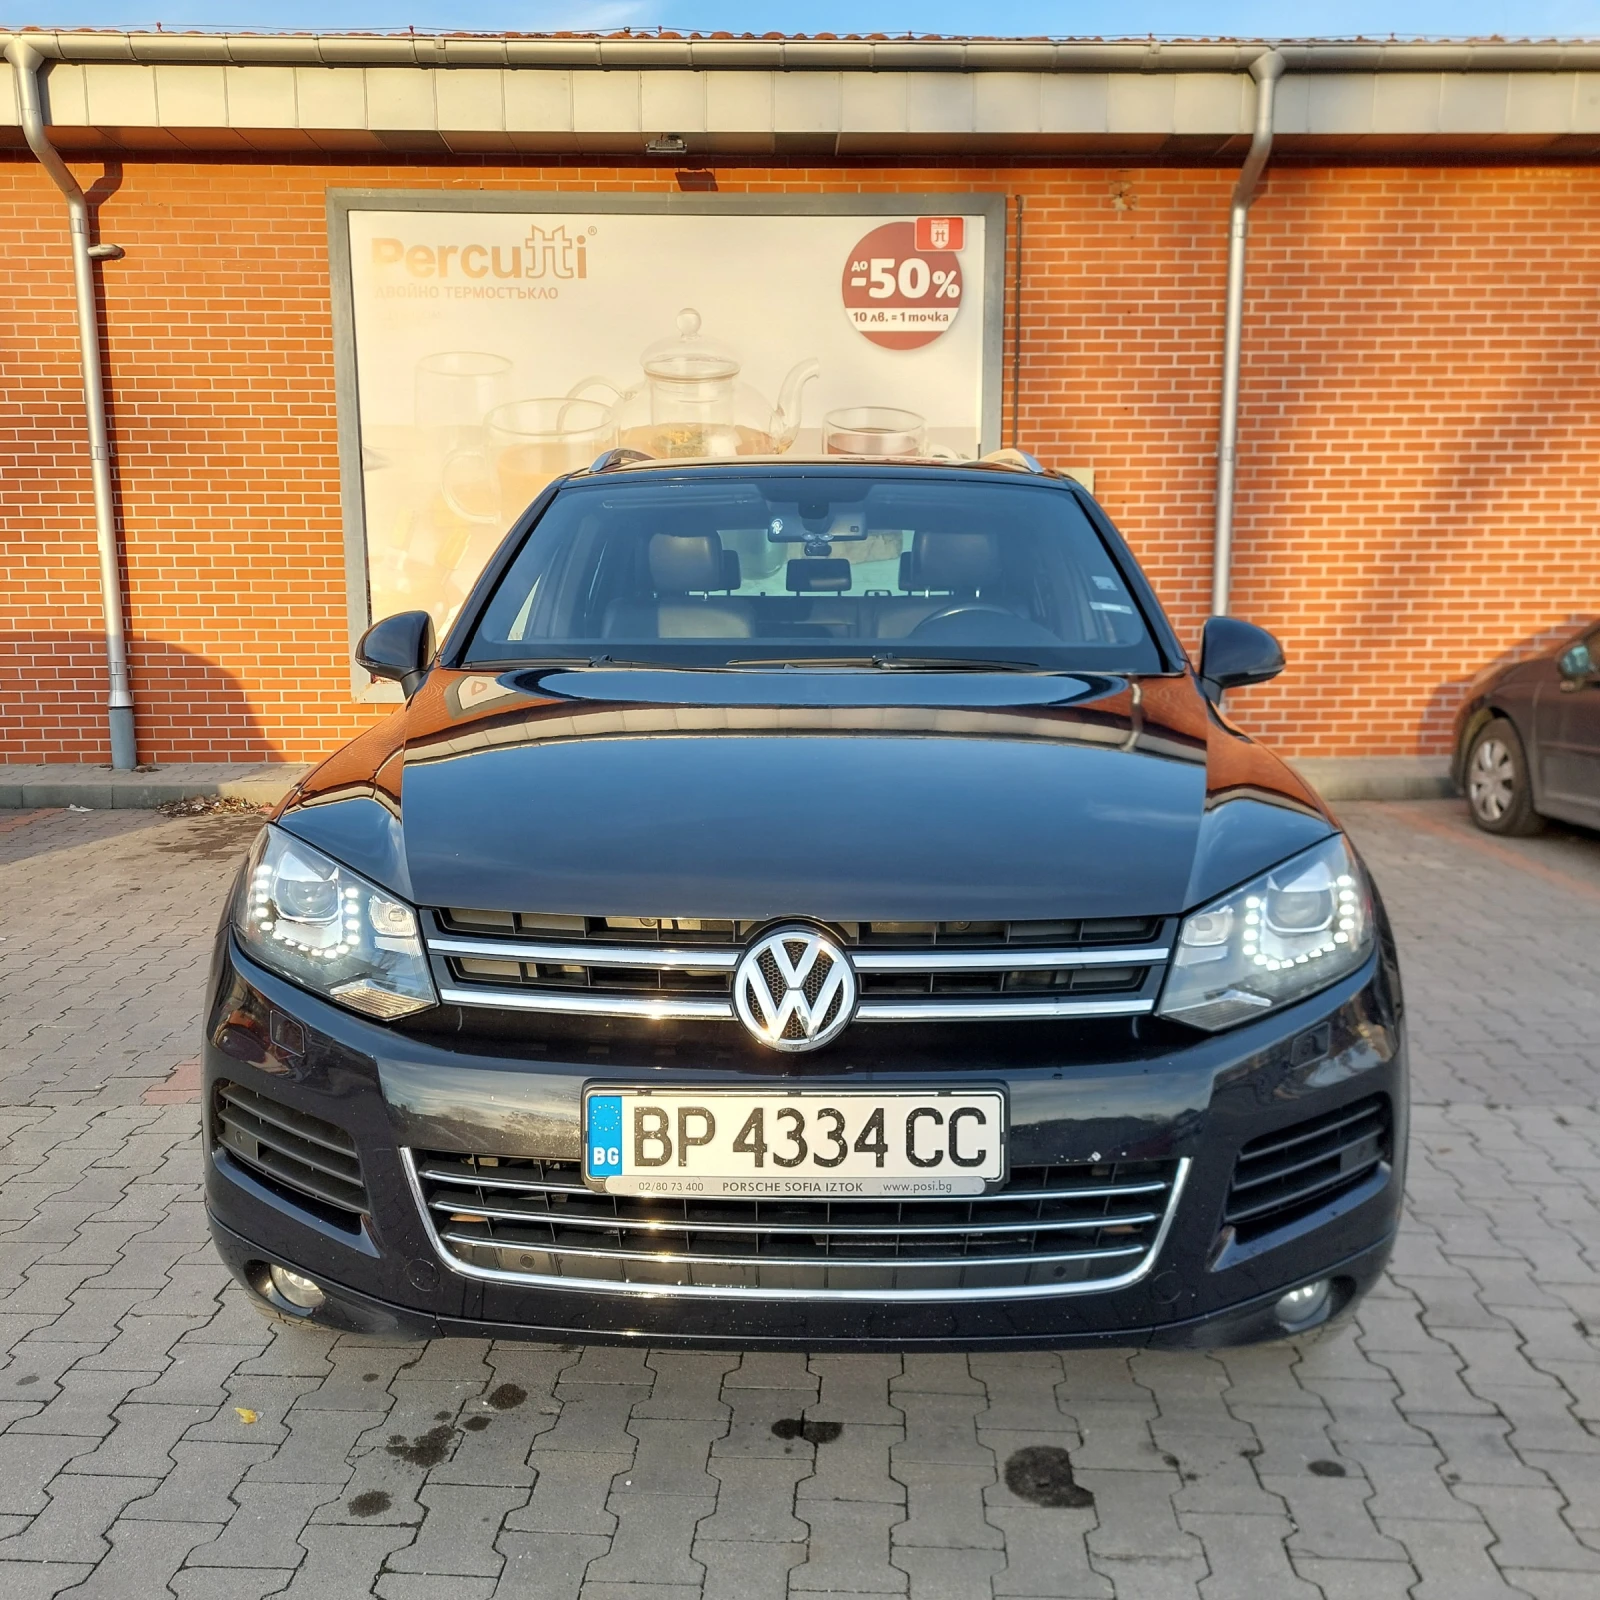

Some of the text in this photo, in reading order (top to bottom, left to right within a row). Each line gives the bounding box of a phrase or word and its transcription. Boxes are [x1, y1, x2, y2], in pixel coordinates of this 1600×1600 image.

[850, 257, 960, 299] -50%
[446, 286, 559, 300] ТЕРМОСТЪКЛО
[853, 312, 868, 322] 10
[900, 312, 906, 322] 1
[908, 311, 949, 322] точка
[633, 1106, 988, 1168] BP 4334 CC
[593, 1147, 620, 1166] BG
[638, 1180, 953, 1193] 02/80 73 400 PORSCHE SOFIA IZTOK www.posi.bg
